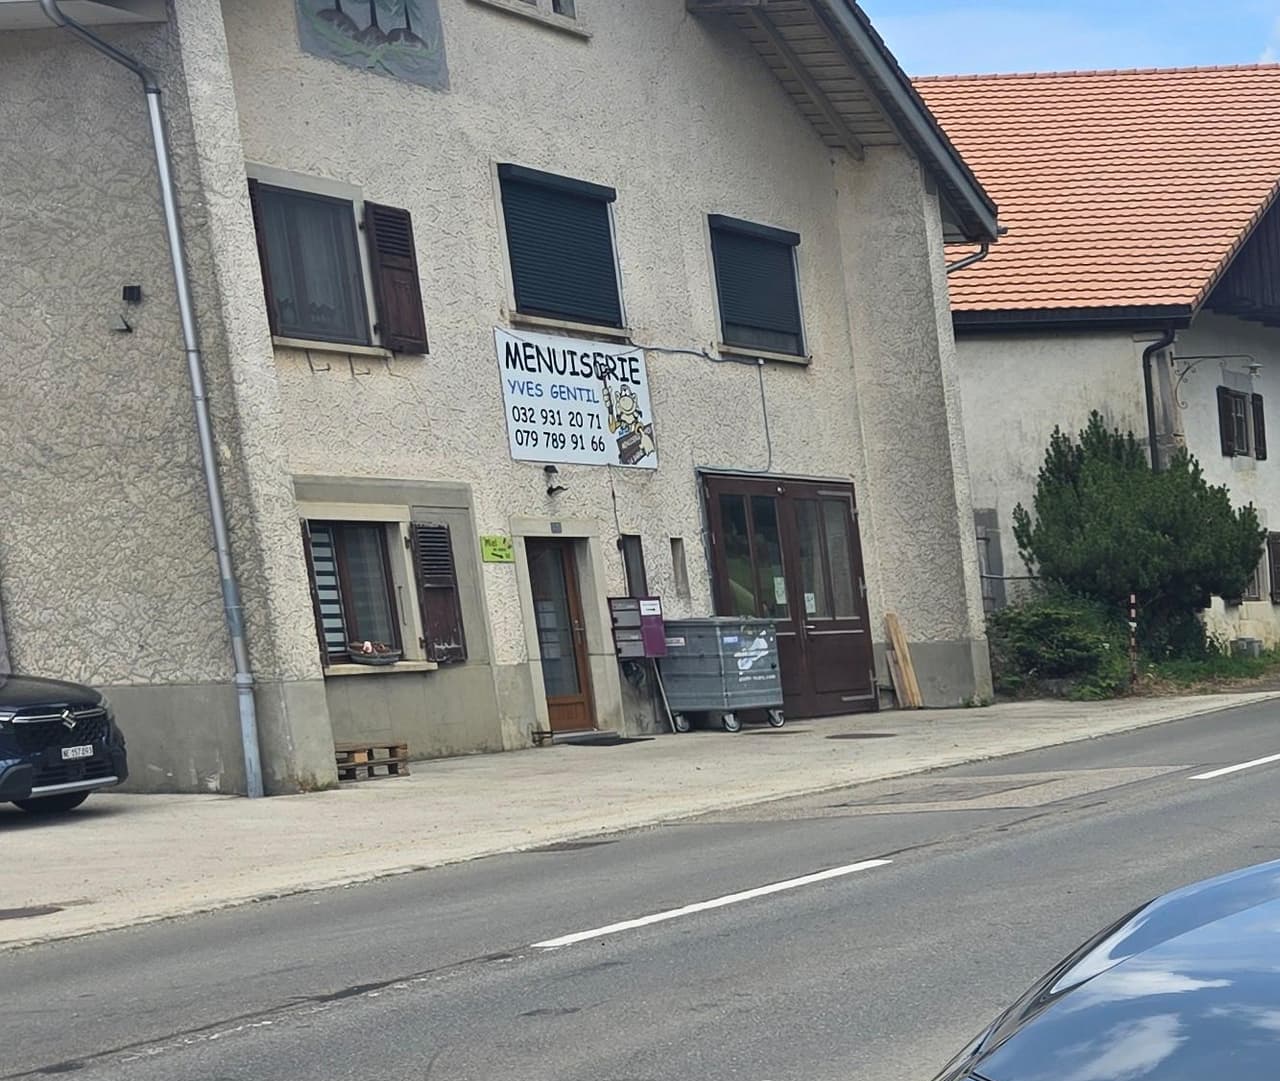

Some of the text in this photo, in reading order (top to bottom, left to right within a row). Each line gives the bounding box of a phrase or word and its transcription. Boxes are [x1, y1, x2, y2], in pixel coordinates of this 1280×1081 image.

[505, 341, 642, 385] MENUISERIE
[507, 378, 601, 404] YVES GENTIL
[512, 405, 602, 430] 032 931 20 71
[515, 429, 538, 447] 079
[543, 431, 567, 450] 789
[571, 433, 586, 451] 91
[591, 435, 606, 452] 66
